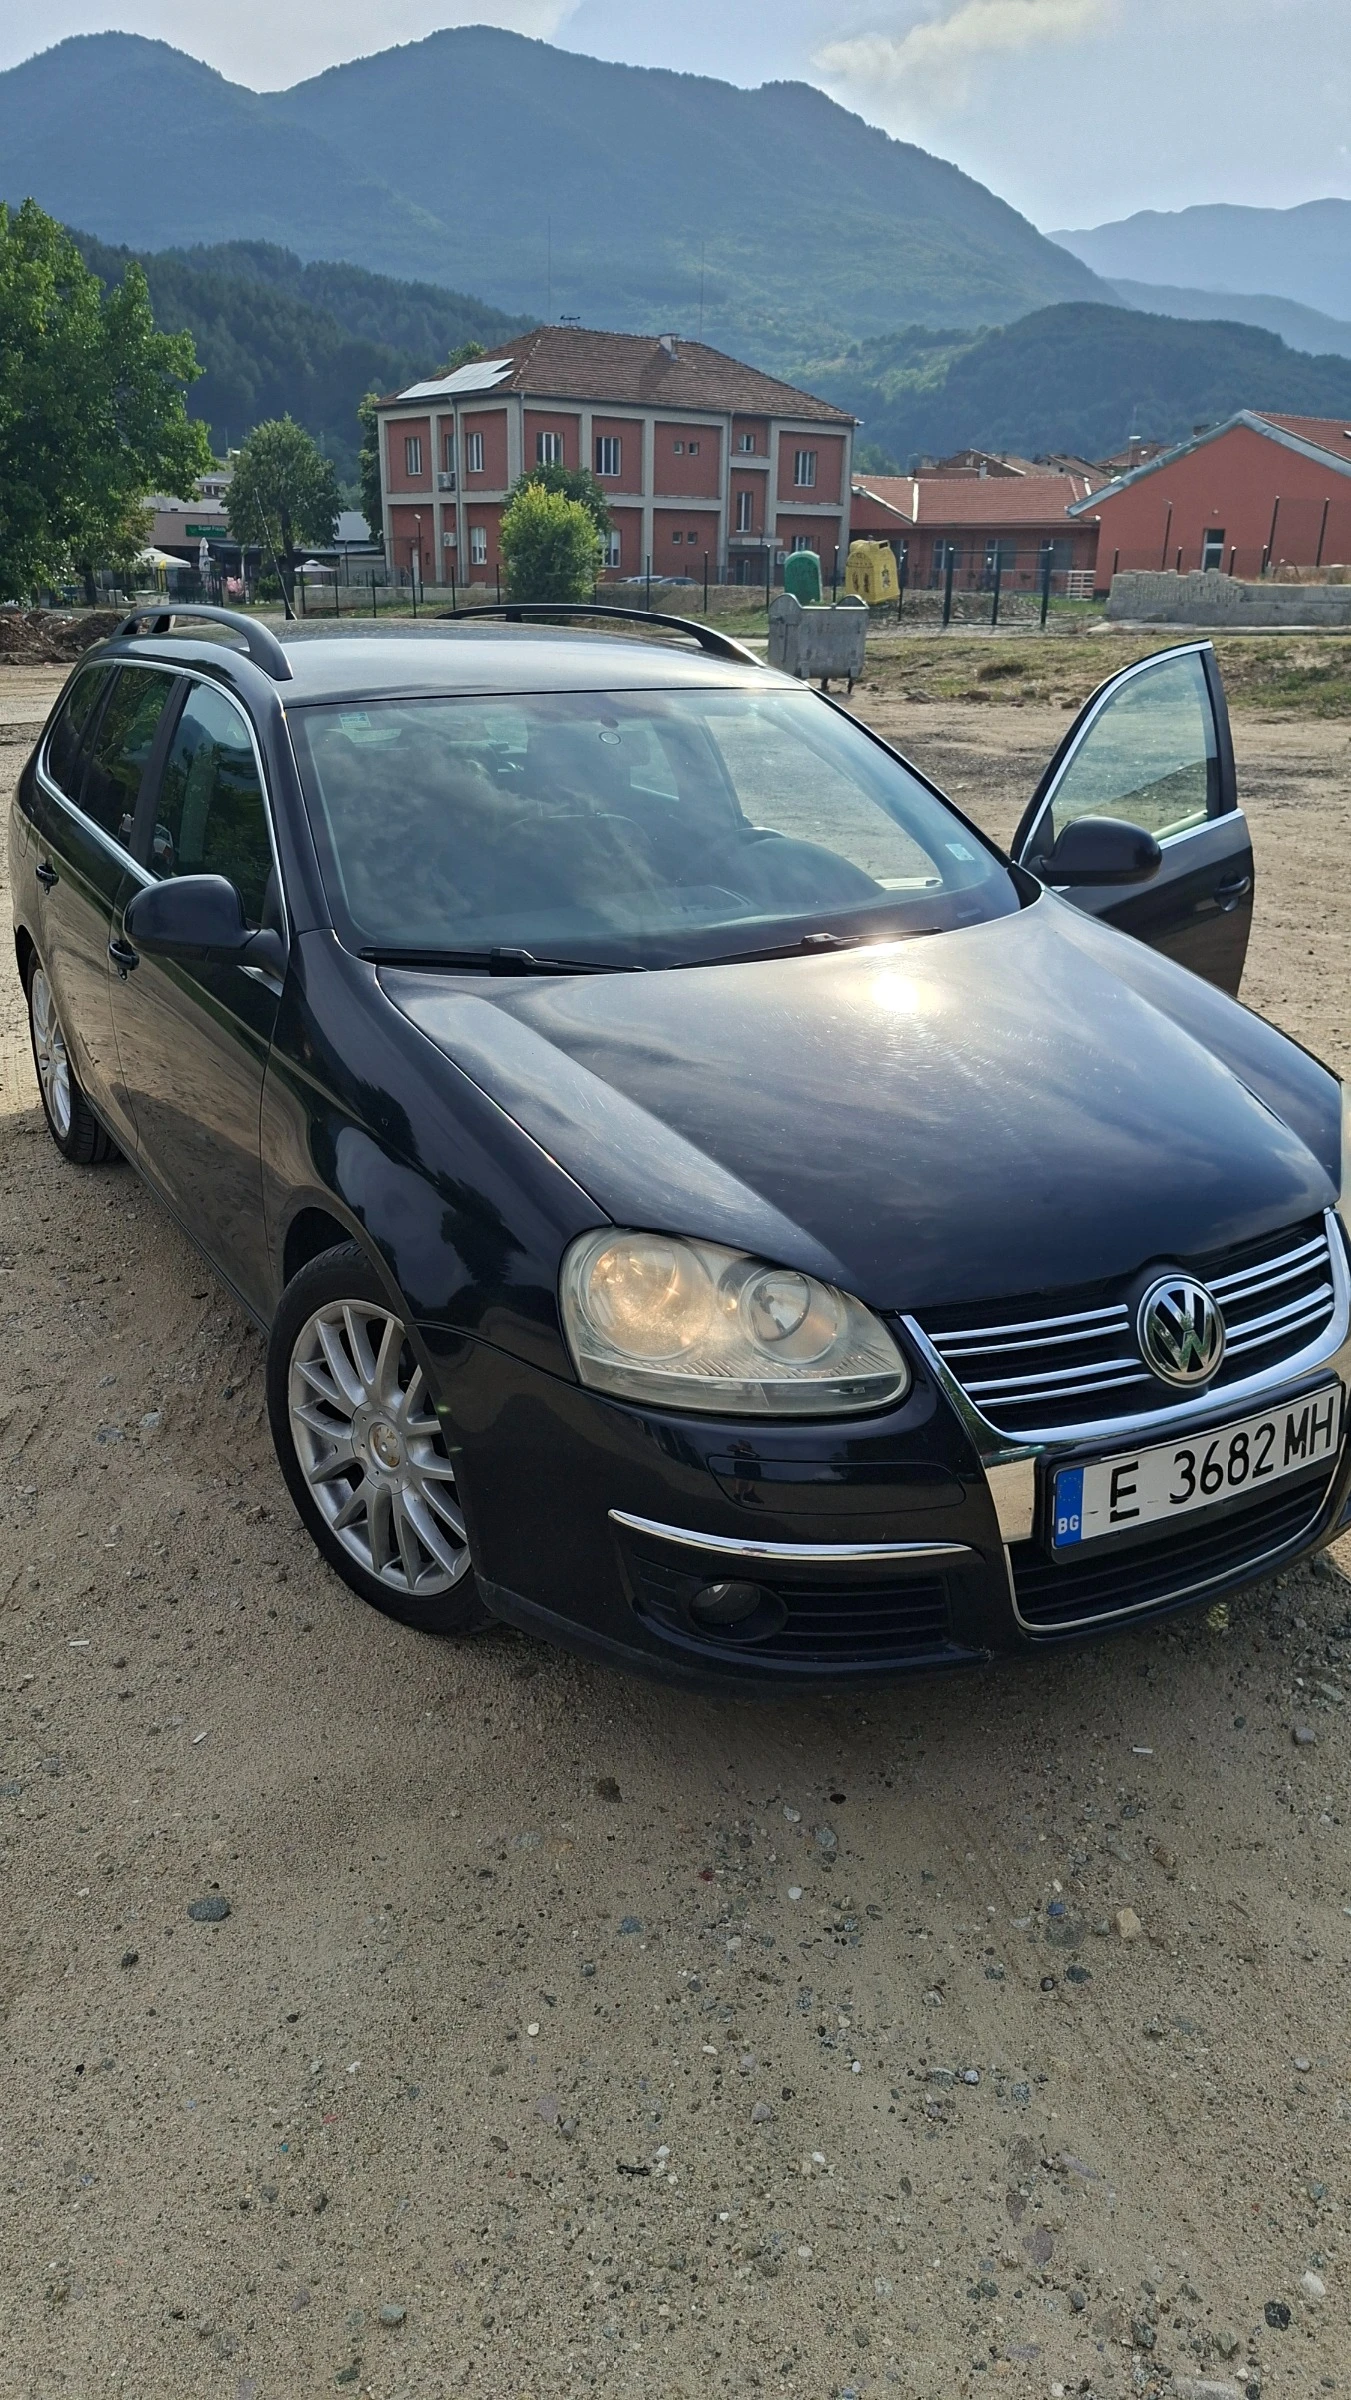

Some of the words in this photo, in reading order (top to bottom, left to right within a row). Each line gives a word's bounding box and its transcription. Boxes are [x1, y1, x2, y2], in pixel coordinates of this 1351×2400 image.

[1110, 1460, 1140, 1523] E
[1169, 1422, 1276, 1505] 3682
[1283, 1396, 1335, 1467] MH
[1057, 1514, 1080, 1535] BG
